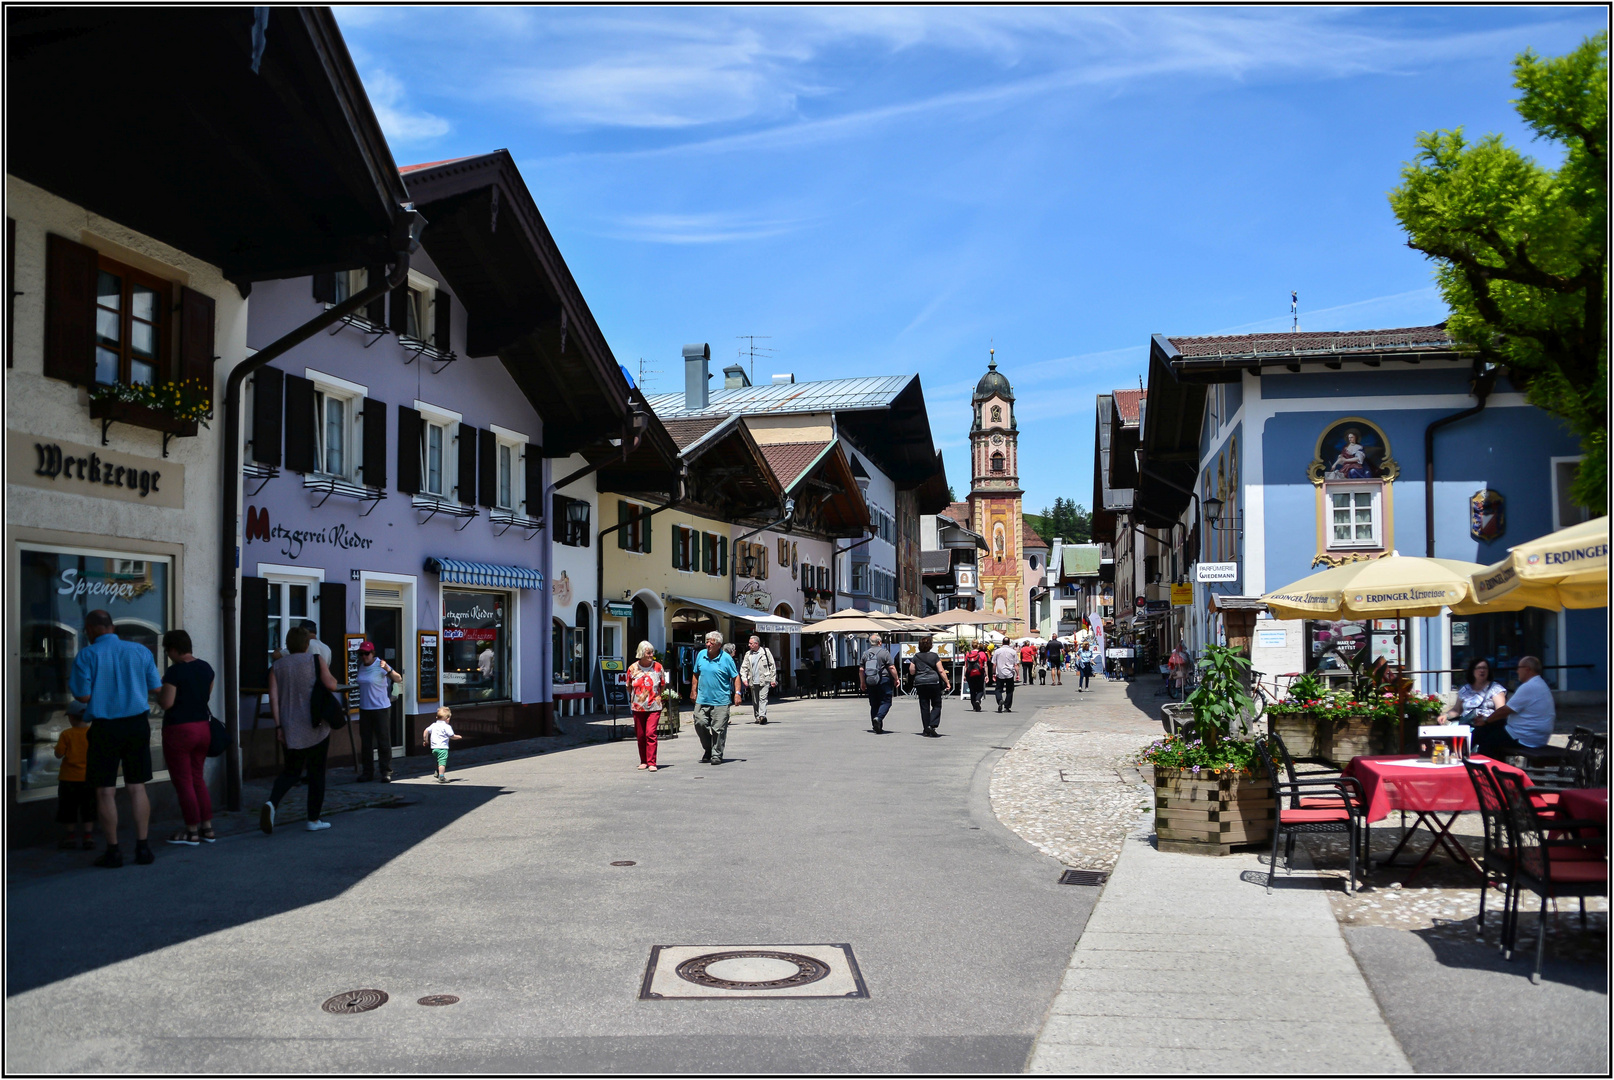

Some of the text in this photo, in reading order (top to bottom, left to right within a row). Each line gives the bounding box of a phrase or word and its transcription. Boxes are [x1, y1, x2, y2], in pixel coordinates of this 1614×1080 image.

[35, 443, 161, 497] Werkzeuge
[246, 505, 373, 559] Metzgerei Rieder
[1545, 544, 1608, 565] ERDINGER
[352, 570, 360, 580] 44
[57, 568, 135, 604] Sprenger
[1366, 592, 1409, 603] ERDINGER
[470, 605, 494, 621] Rieder
